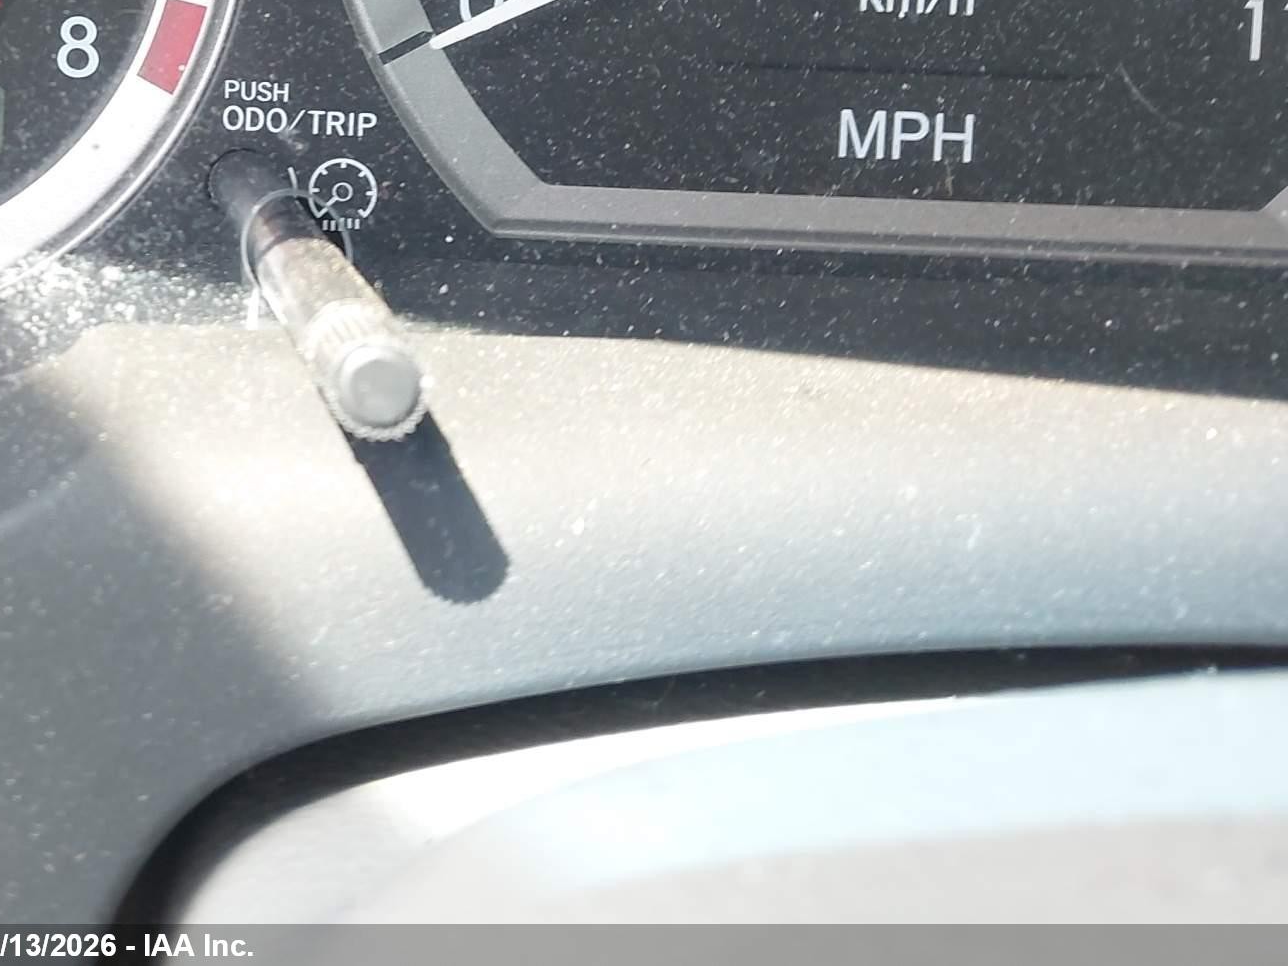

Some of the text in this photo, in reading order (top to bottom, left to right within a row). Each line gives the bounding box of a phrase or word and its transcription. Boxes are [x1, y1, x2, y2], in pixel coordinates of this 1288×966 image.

[57, 16, 99, 78] 8
[224, 80, 290, 102] PUSH
[223, 105, 377, 137] ODO/TRIP
[838, 109, 974, 164] MPH
